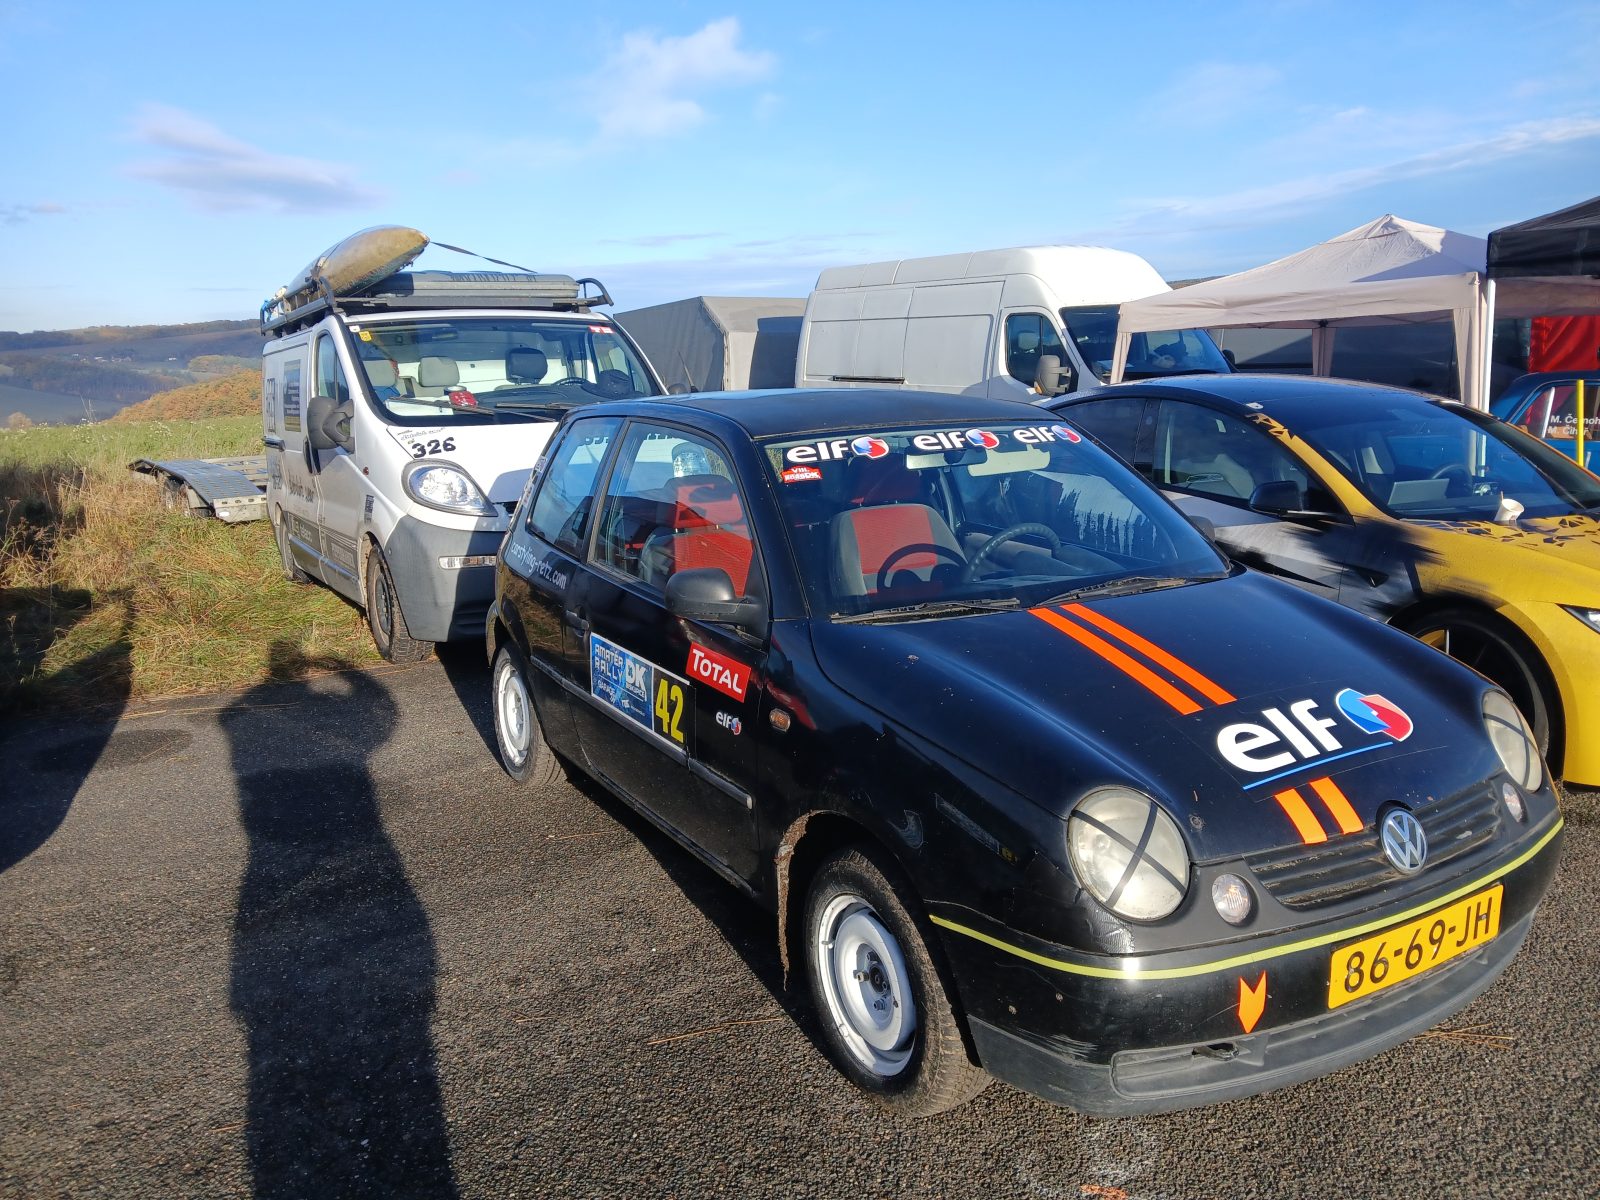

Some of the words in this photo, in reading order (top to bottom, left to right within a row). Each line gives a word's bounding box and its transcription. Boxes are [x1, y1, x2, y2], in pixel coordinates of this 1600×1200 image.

[1564, 413, 1600, 425] Čenoh
[411, 436, 456, 458] 326
[913, 431, 966, 450] elf
[1013, 427, 1056, 443] elf
[786, 440, 849, 462] elf
[511, 541, 567, 590] carstyling-retz.com
[594, 656, 623, 681] RALLY
[626, 659, 647, 693] DK
[692, 648, 743, 695] TOTAL
[655, 678, 684, 744] 42
[715, 711, 733, 729] elf
[1216, 699, 1343, 773] elf
[1343, 896, 1493, 994] 86-69-JH
